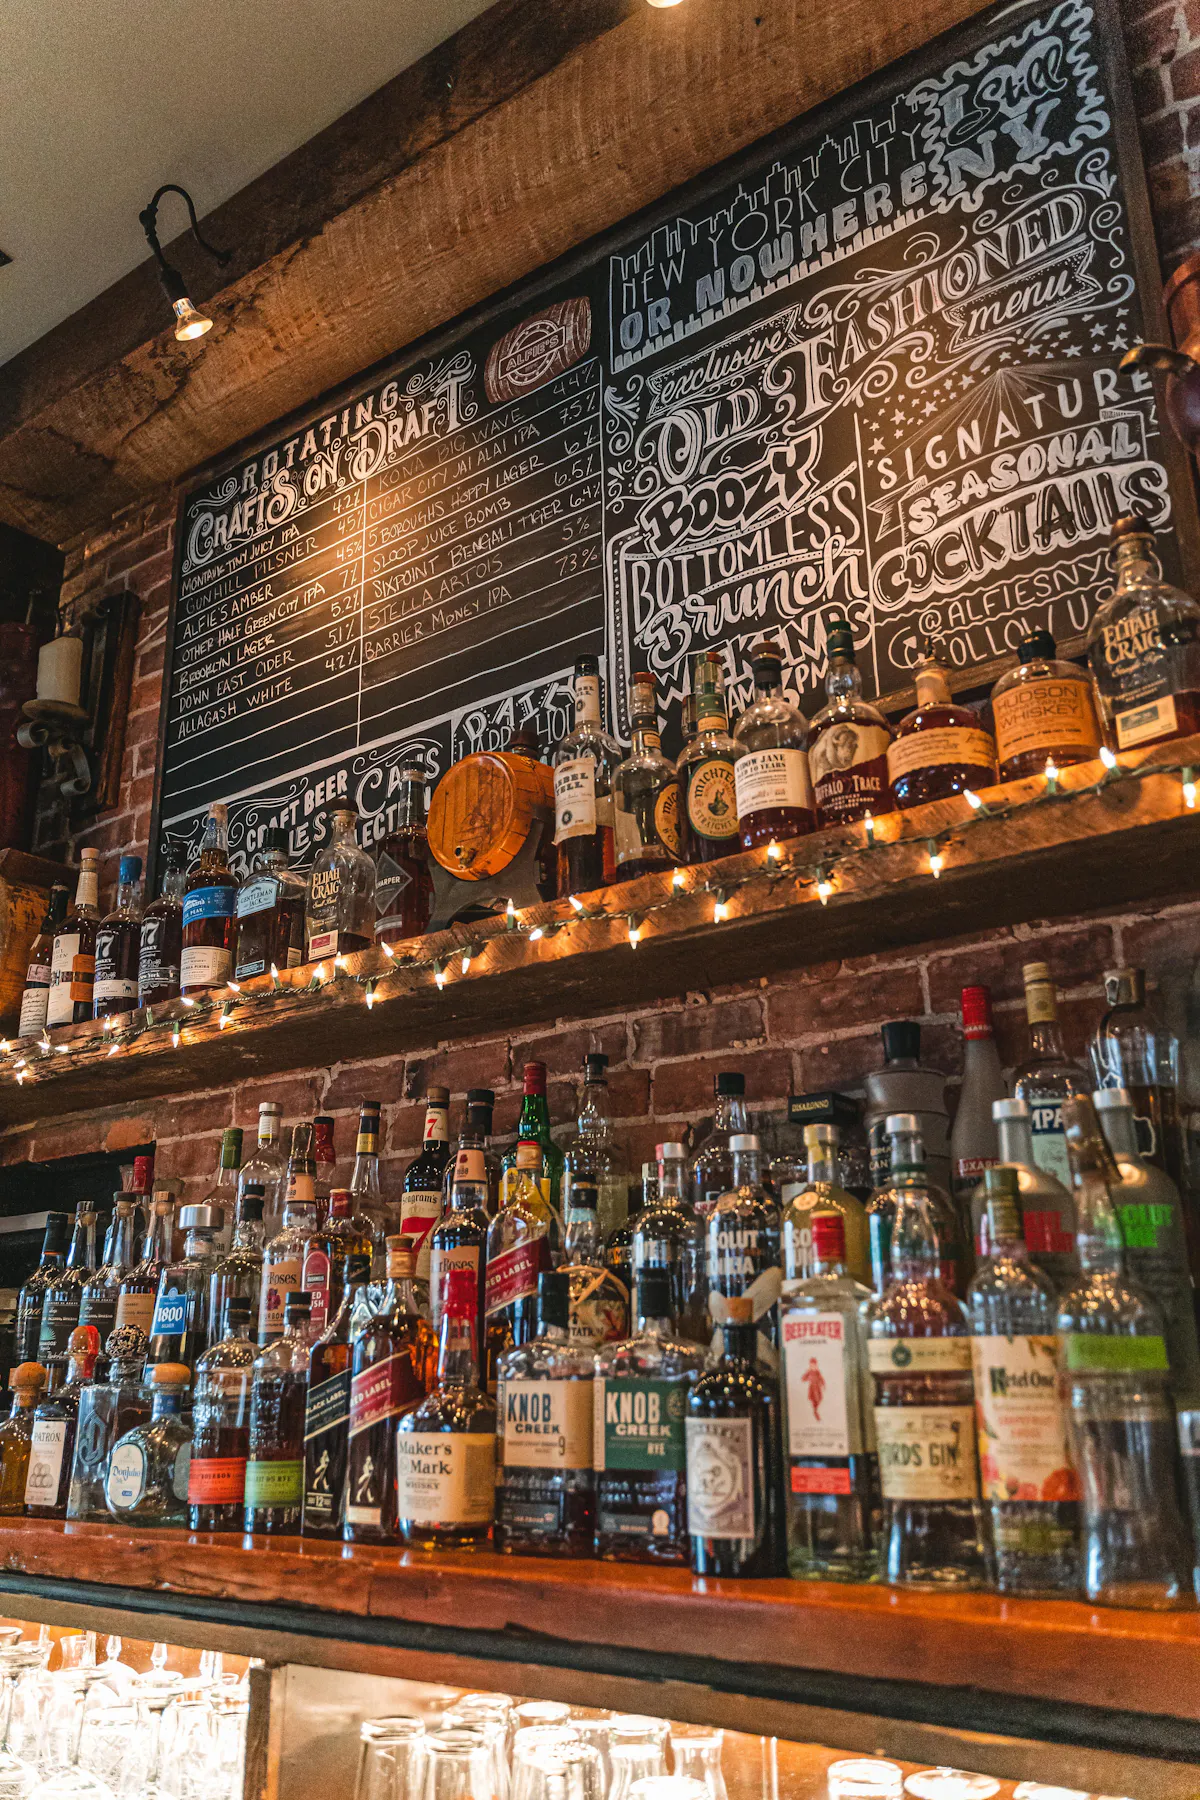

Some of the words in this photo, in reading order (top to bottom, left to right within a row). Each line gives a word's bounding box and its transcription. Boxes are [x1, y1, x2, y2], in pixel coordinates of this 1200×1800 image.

[622, 249, 686, 314] NEW
[708, 181, 818, 267] YORK
[840, 123, 921, 192] CITY
[619, 297, 672, 350] OR
[696, 161, 928, 313] NOWHERE
[967, 270, 1073, 335] menu
[505, 334, 559, 372] ALFIE'S
[635, 386, 762, 485] OLD
[764, 191, 1088, 420] FASHIONED
[661, 330, 787, 404] exclusive
[241, 381, 399, 493] ROTATING
[303, 448, 341, 497] ON
[349, 370, 472, 481] DRAFT
[369, 486, 414, 520] CIGAR
[417, 470, 448, 495] CITY
[452, 456, 473, 479] JAI
[476, 439, 507, 470] ALAI
[514, 422, 541, 446] IPA
[558, 391, 596, 424] 7.5%
[378, 457, 426, 490] KONA
[437, 433, 466, 463] BIG
[472, 406, 526, 444] WAVE
[877, 368, 1153, 490] SIGNATURE
[367, 527, 378, 548] 5
[381, 500, 445, 543] BOROUGHS
[450, 477, 490, 506] HOPPY
[495, 454, 545, 490] LAGER
[563, 425, 595, 455] 6%
[640, 426, 820, 558] BOOZY
[908, 422, 1141, 534] SEASONAL
[181, 565, 225, 597] MONTAUK
[226, 552, 248, 574] TINY
[249, 536, 275, 560] JUICY
[281, 523, 300, 544] IPA
[332, 488, 361, 513] 4.2%
[371, 538, 419, 574] SLOOP
[421, 518, 458, 551] JUICE
[464, 496, 512, 526] BOMB
[553, 454, 594, 487] 6.5%
[371, 556, 439, 598] SIXPOINT
[448, 520, 513, 568] BENGALI
[517, 499, 564, 530] TIGER
[568, 481, 601, 507] 6.4%
[872, 461, 1172, 612] COCKTAILS
[254, 536, 319, 579] PILSNER
[337, 514, 364, 536] 4.5%
[368, 587, 434, 630] STELLA
[438, 553, 503, 600] ARTOIS
[561, 515, 590, 541] 5%
[632, 481, 860, 634] BOTTOMLESS
[181, 637, 214, 663] OTHER
[217, 622, 242, 647] HALF
[244, 608, 277, 635] GREEN
[278, 596, 299, 617] CITY
[303, 581, 326, 606] IPA
[339, 562, 359, 589] 7%
[183, 606, 228, 640] ALFIE'S
[231, 583, 274, 617] AMBER
[336, 540, 363, 562] 4.5%
[644, 533, 868, 671] Brunch
[179, 651, 231, 691] BROOKLYN
[236, 632, 275, 662] LAGER
[331, 590, 360, 618] 5.2%
[364, 621, 424, 661] BARRIER
[487, 584, 513, 607] IPA
[931, 605, 1053, 666] OLLOW
[1102, 609, 1159, 647] ELIJAH
[1104, 629, 1161, 665] CRAIG
[177, 700, 238, 739] ALLAGASH
[246, 676, 294, 708] WHITE
[325, 645, 358, 672] 4.2%
[179, 688, 210, 713] DOWN
[216, 670, 248, 697] EAST
[255, 649, 296, 678] CIDER
[324, 619, 355, 648] 5.1%
[997, 685, 1078, 712] HUDSON
[999, 704, 1078, 730] WHISKEY
[760, 753, 785, 763] JANE
[760, 762, 786, 770] YEARS
[854, 774, 881, 791] TRACE
[304, 769, 348, 817] BEER
[241, 888, 273, 904] GENTLEMAN
[311, 881, 340, 901] CRAIG
[312, 867, 340, 886] ELIJAH
[427, 1119, 437, 1138] 7
[312, 1292, 322, 1300] ED
[485, 1275, 501, 1289] RED
[503, 1259, 533, 1281] LABEL
[158, 1307, 183, 1322] 1800
[784, 1320, 842, 1342] BEEFEATER
[306, 1401, 325, 1415] BLACK
[326, 1390, 347, 1403] LABEL
[364, 1378, 393, 1399] LABEL
[508, 1393, 551, 1423] KNOB
[606, 1392, 660, 1423] KNOB
[399, 1441, 452, 1456] Maker's
[515, 1424, 561, 1434] CREEK
[558, 1435, 566, 1456] 9
[615, 1424, 671, 1437] CREEK
[410, 1460, 453, 1476] Mark
[315, 1495, 324, 1507] 12
